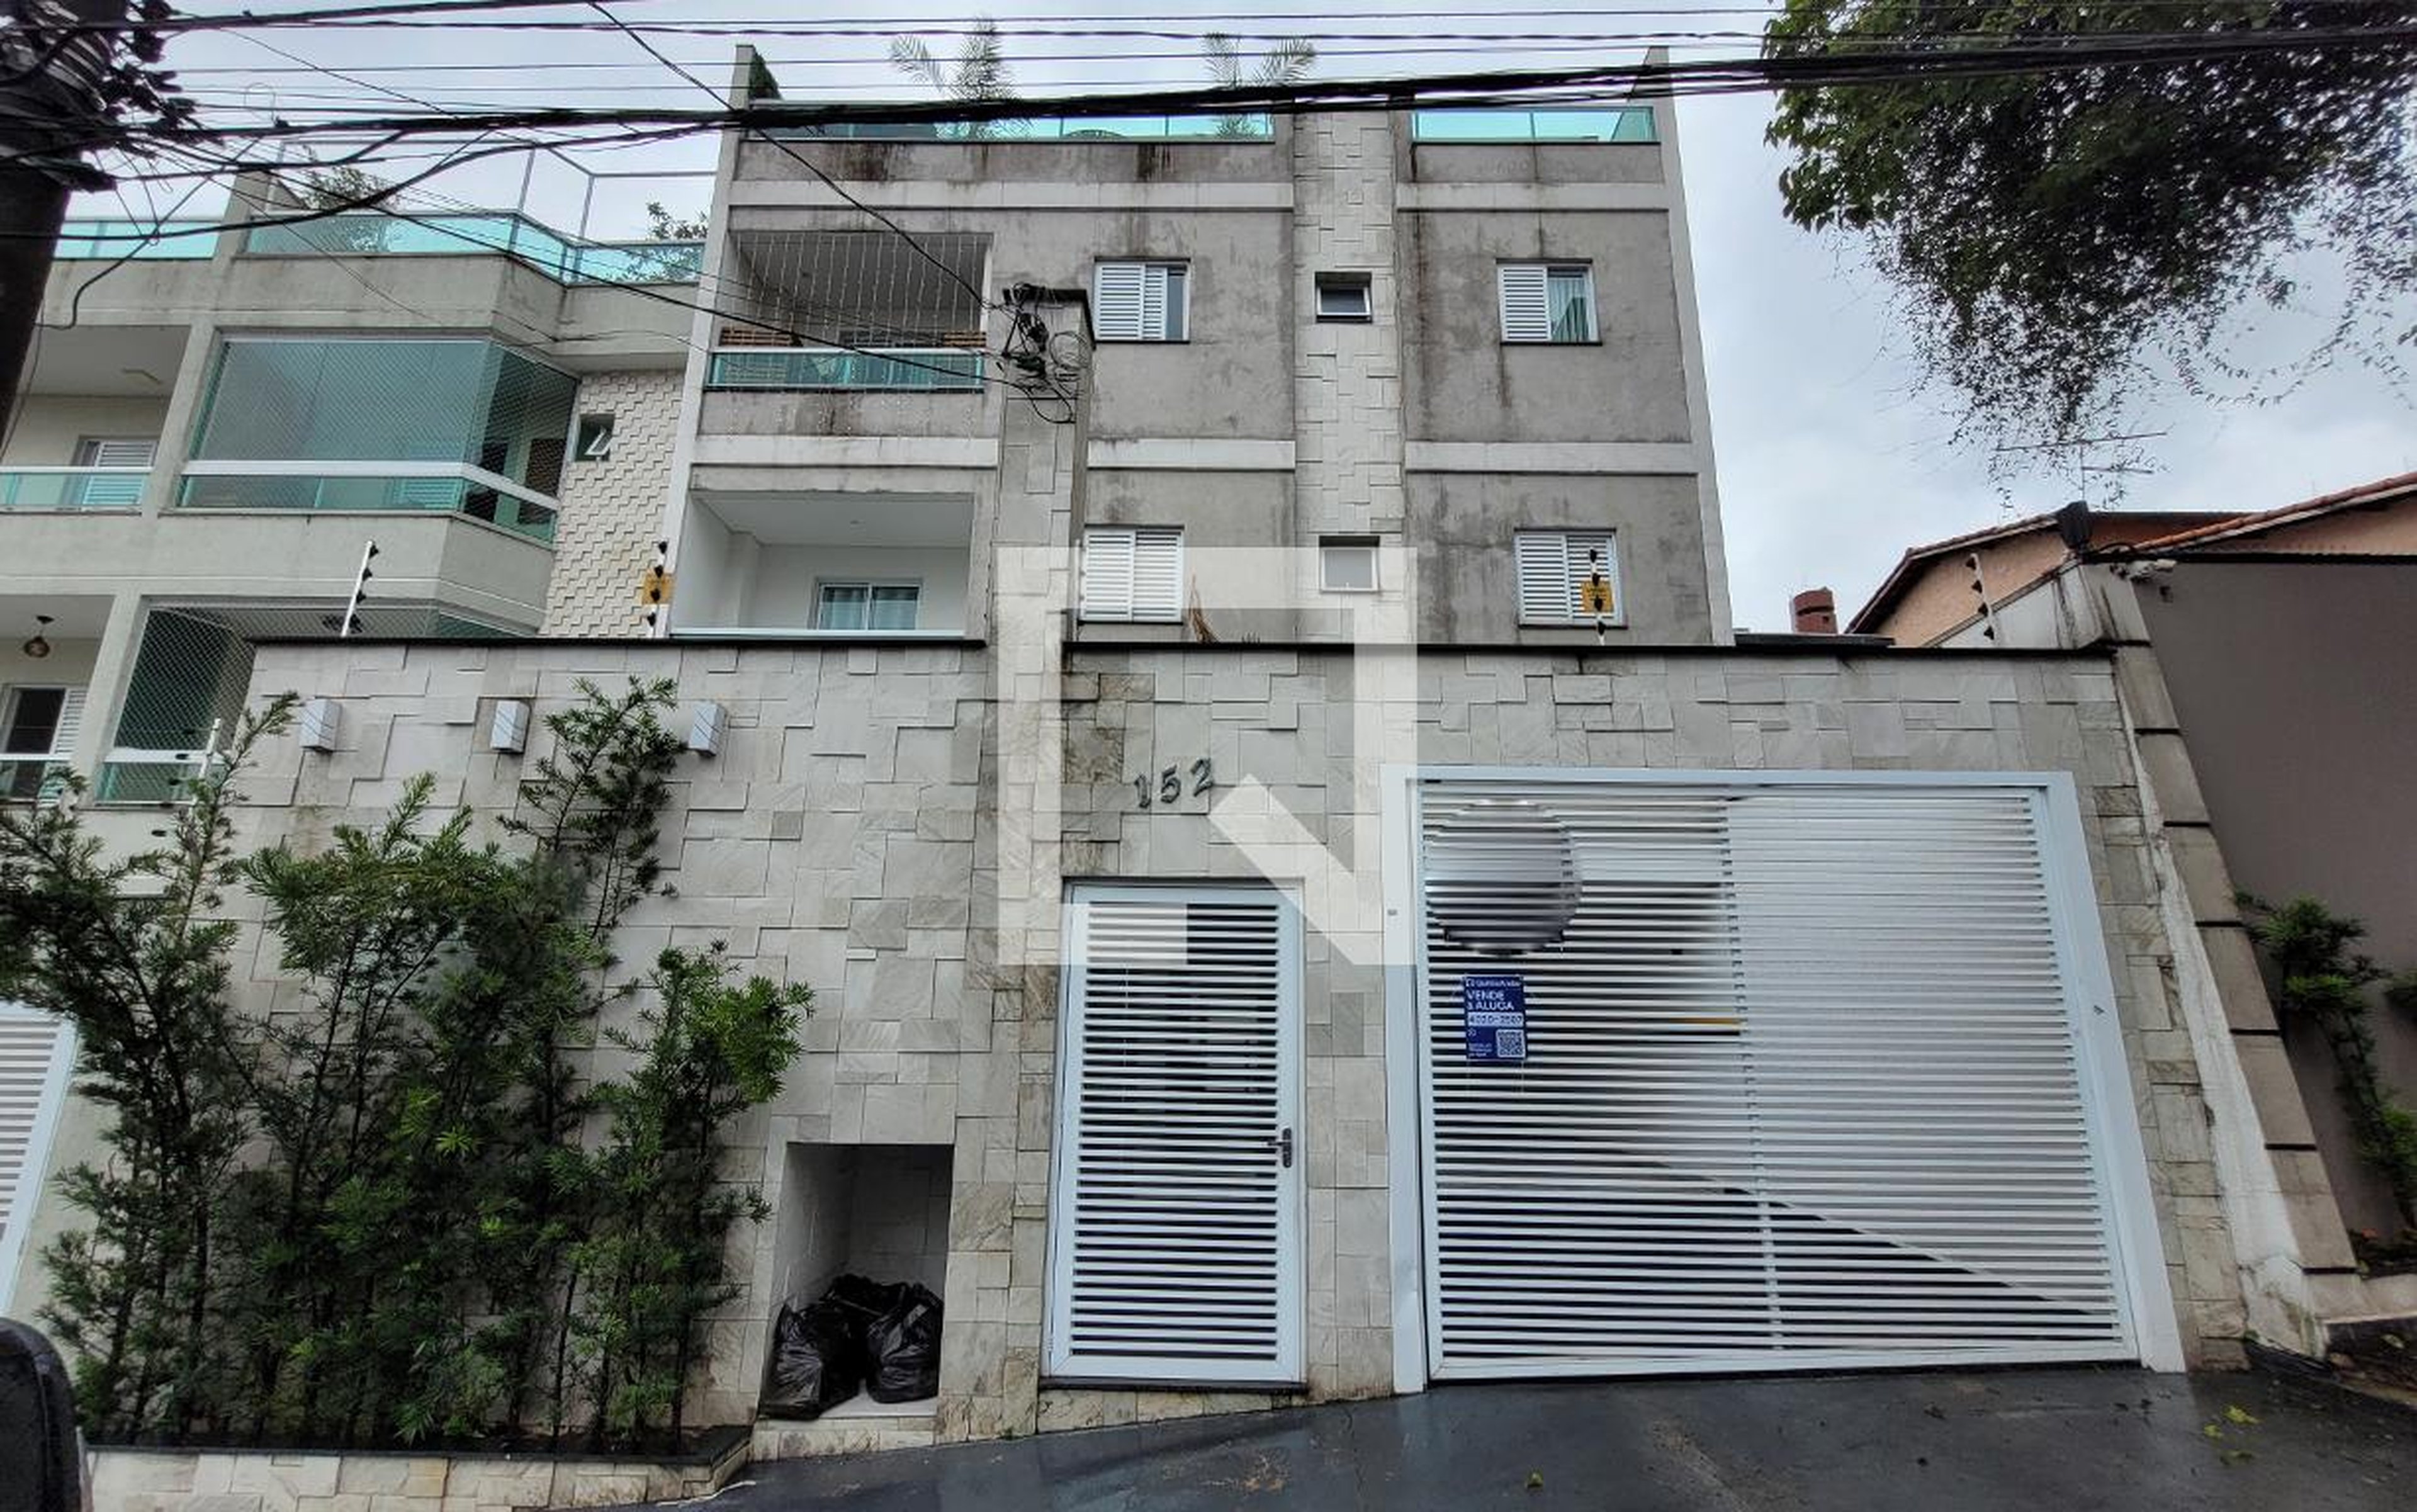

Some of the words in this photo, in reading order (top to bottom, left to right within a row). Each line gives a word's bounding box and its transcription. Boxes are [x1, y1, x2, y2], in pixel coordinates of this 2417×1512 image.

[1134, 757, 1214, 809] 152
[1467, 990, 1504, 1001] VENDE
[1475, 1001, 1514, 1010] ALUGA
